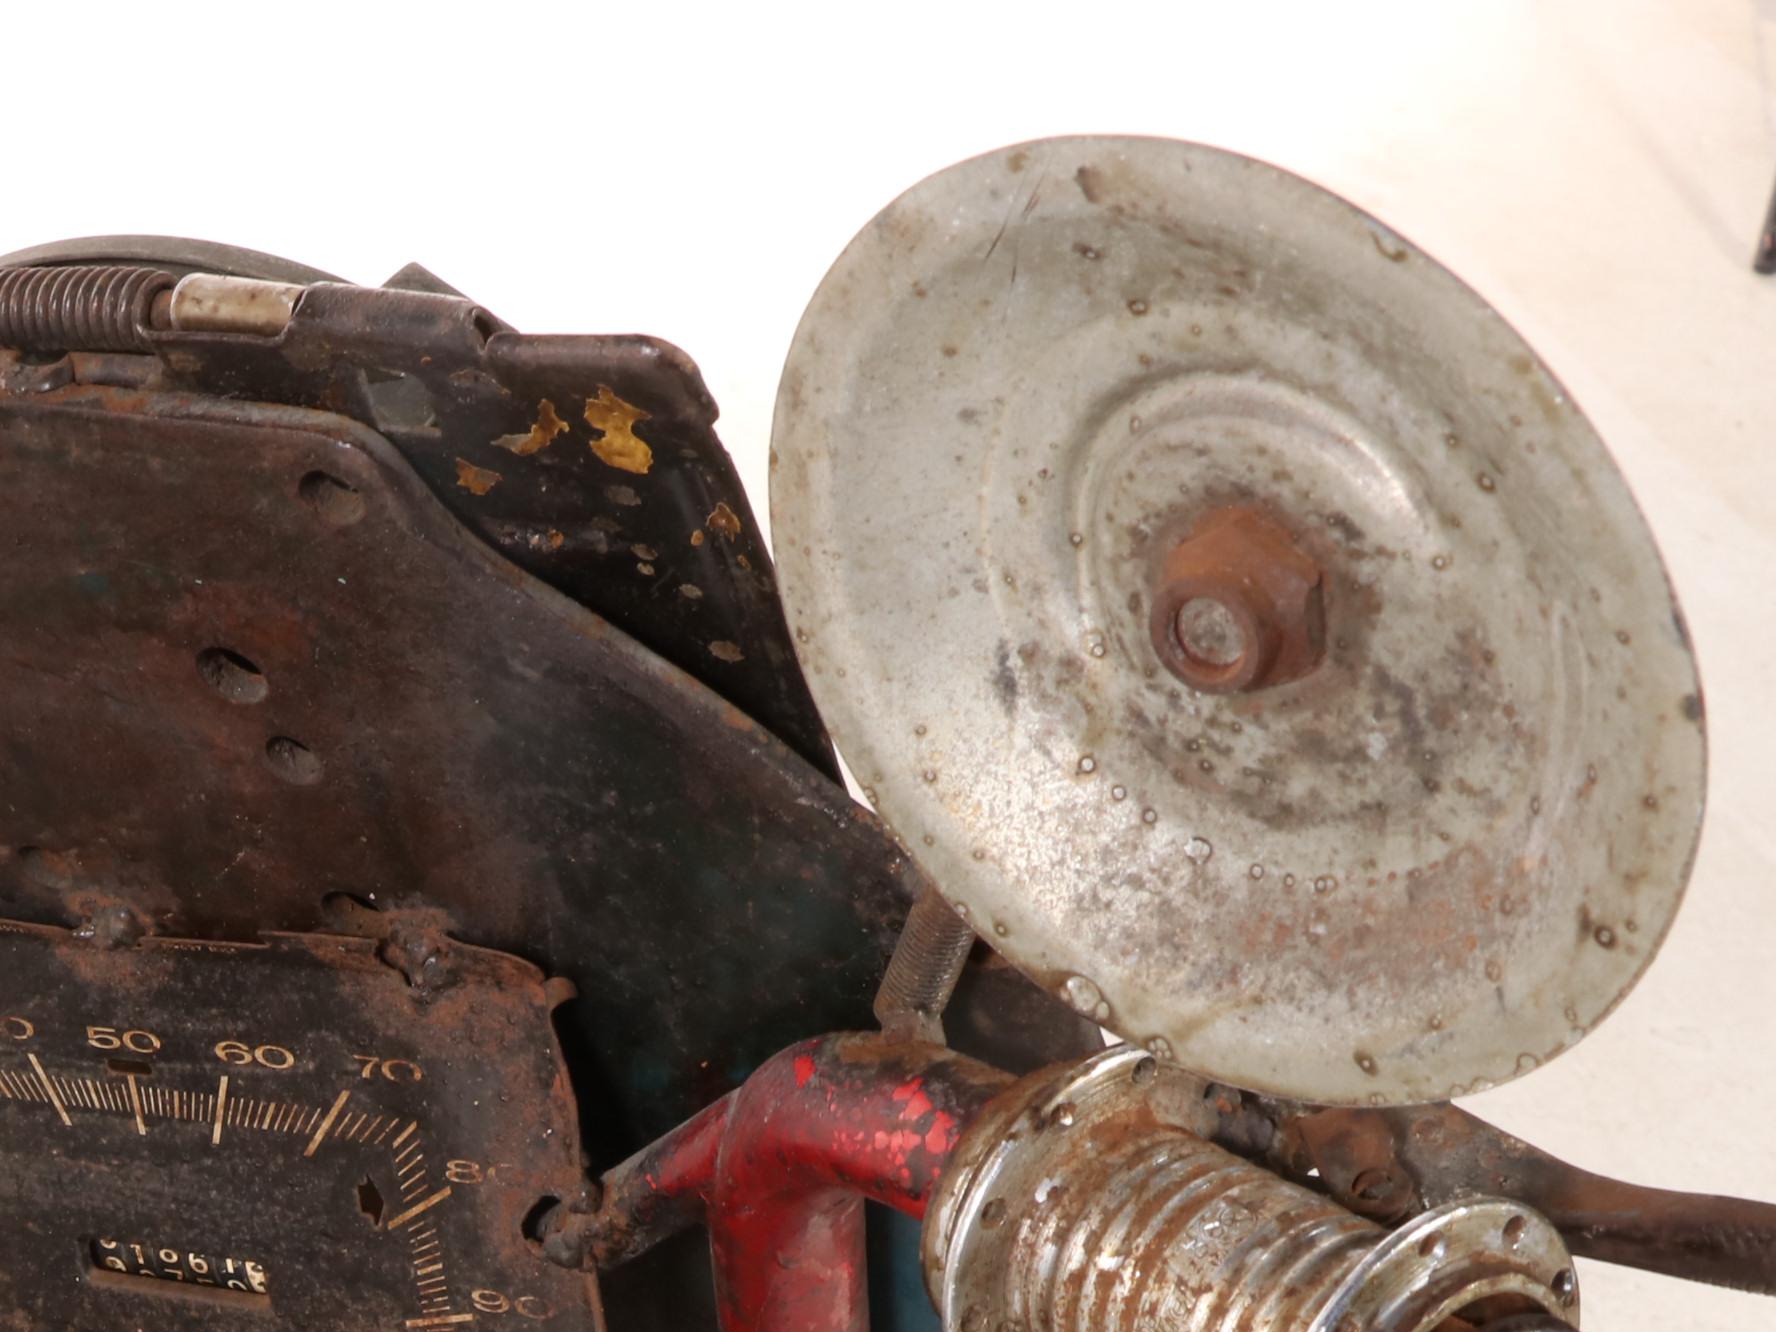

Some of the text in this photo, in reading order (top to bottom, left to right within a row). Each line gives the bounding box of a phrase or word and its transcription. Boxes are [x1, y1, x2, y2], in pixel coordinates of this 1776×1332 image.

[86, 1026, 162, 1054] 50
[214, 1041, 295, 1069] 60
[352, 1054, 423, 1083] 70
[471, 1289, 555, 1320] 90
